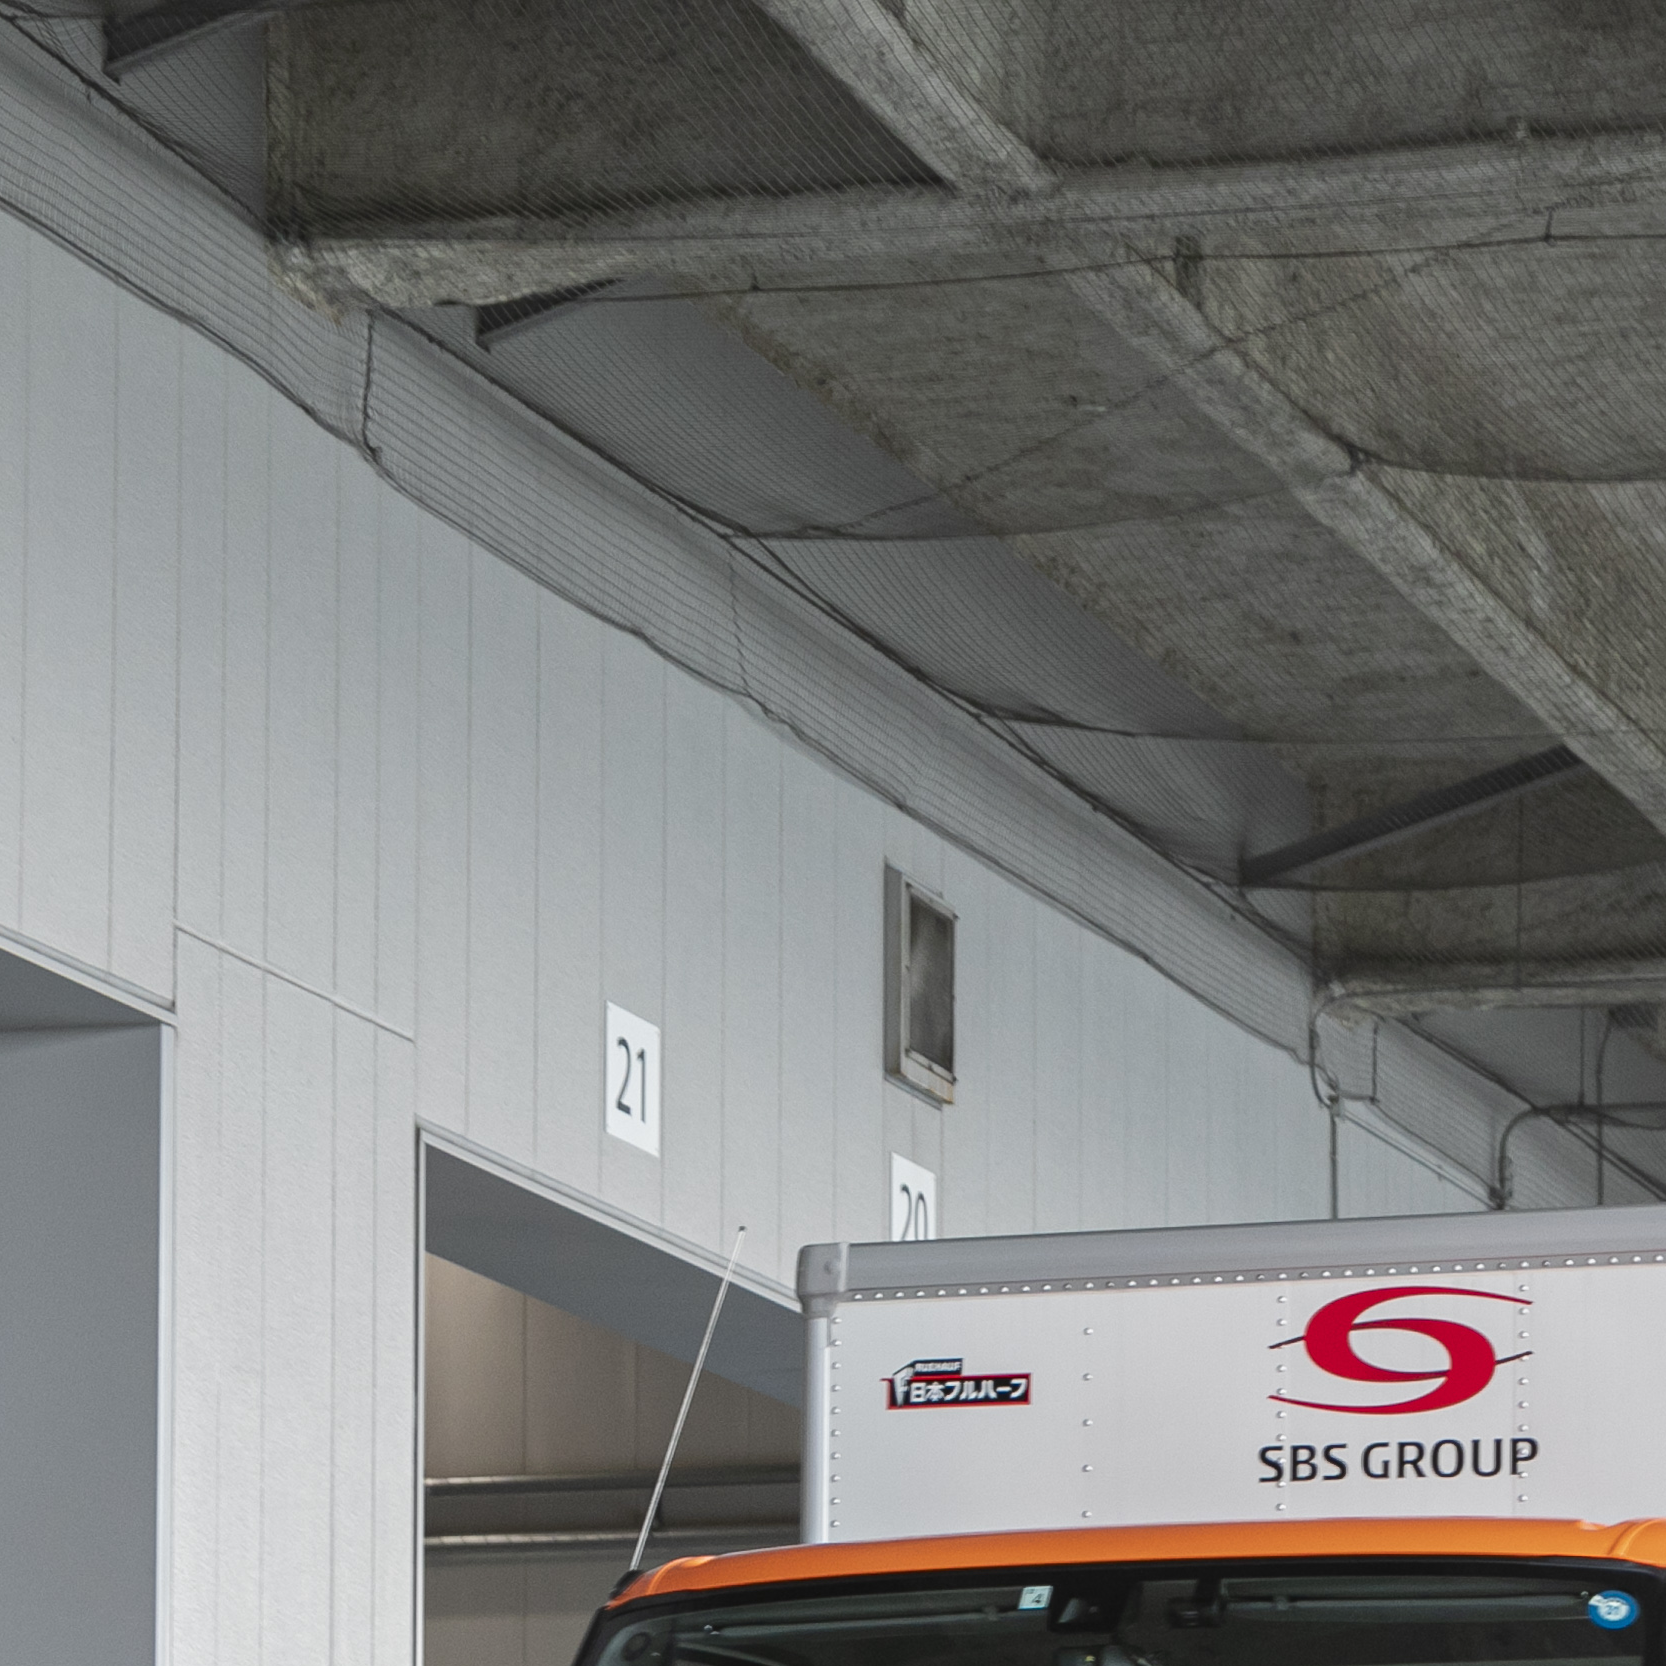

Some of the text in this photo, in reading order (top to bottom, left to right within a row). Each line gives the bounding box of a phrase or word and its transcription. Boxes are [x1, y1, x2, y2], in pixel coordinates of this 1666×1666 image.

[616, 1036, 646, 1124] 21
[899, 1183, 928, 1241] 20
[909, 1377, 1029, 1404] 日本フルハーフ
[1257, 1437, 1540, 1483] SBS GROUP
